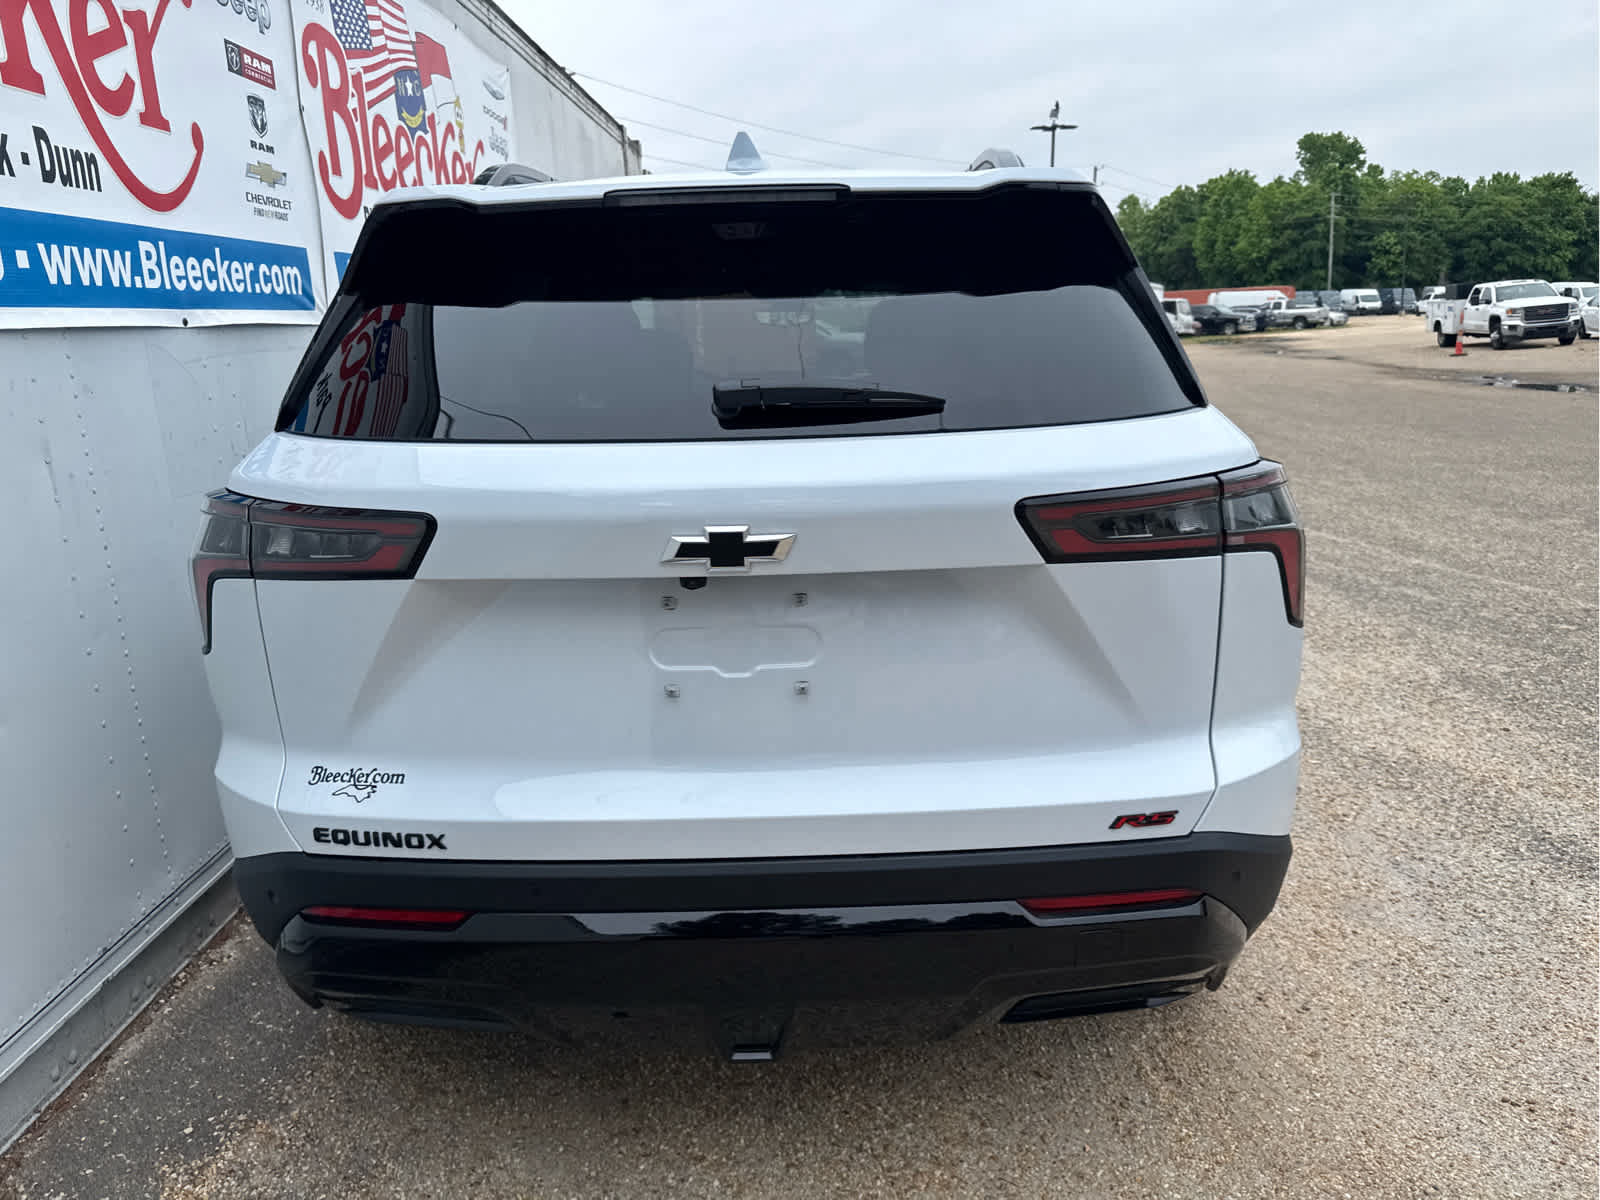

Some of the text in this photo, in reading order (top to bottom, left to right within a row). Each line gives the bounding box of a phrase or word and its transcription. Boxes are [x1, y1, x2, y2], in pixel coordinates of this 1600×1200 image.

[243, 53, 272, 75] RAM
[250, 140, 275, 155] RAM
[32, 125, 102, 193] Dunn
[245, 191, 292, 210] CHEVROLET
[37, 240, 303, 296] www.Bleecker.com
[1108, 809, 1179, 829] RS
[313, 827, 447, 850] EQUINOX
